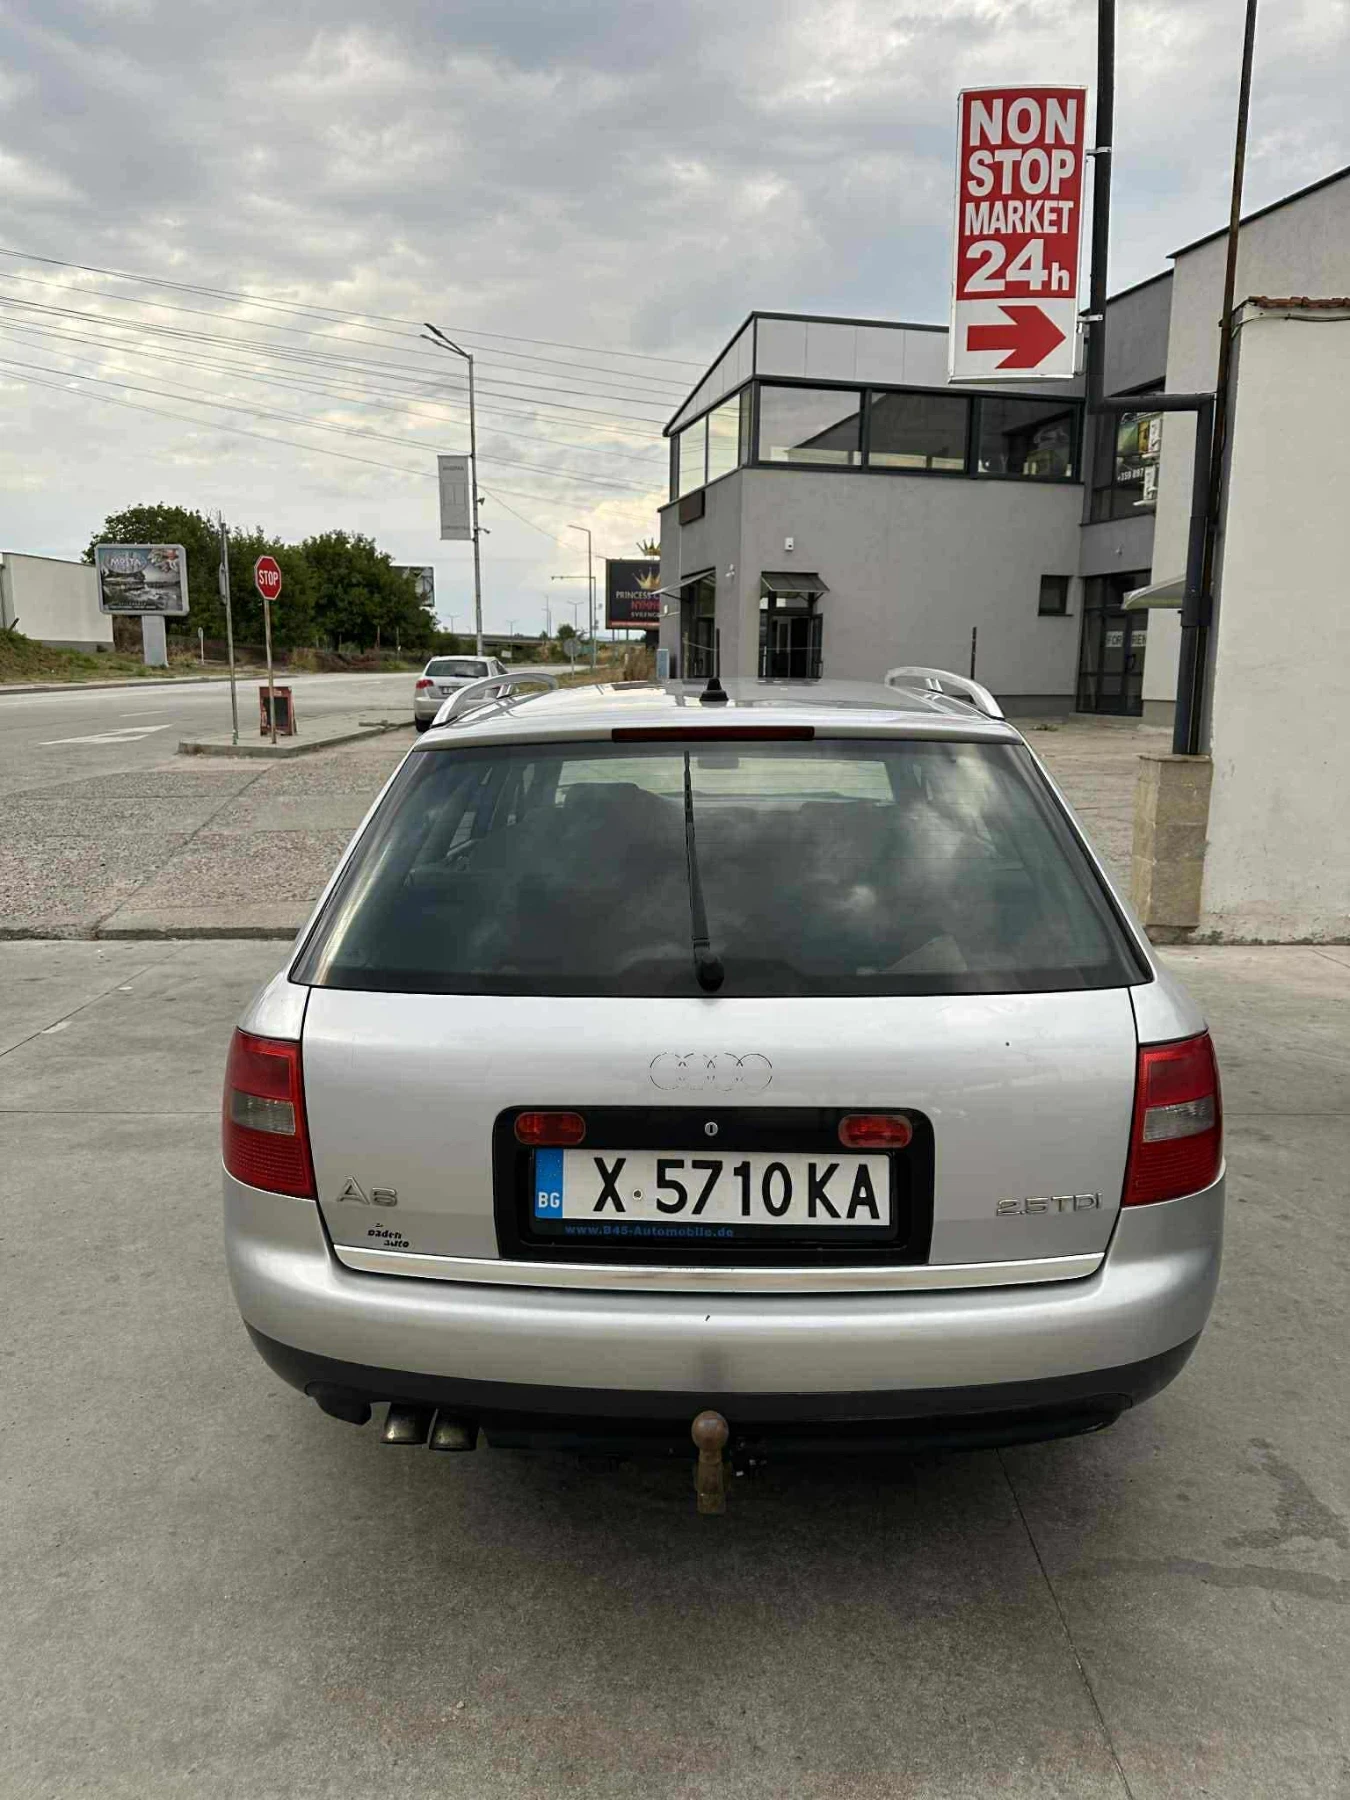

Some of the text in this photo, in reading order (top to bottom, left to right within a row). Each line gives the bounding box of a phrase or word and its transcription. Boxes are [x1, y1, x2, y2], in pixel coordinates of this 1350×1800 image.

[969, 96, 1077, 146] NON
[966, 147, 1075, 197] STOP
[964, 200, 1074, 236] MARKET
[963, 238, 1070, 293] 24h
[258, 570, 279, 586] STOP
[1132, 634, 1146, 645] REN
[537, 1192, 561, 1209] BG
[593, 1157, 880, 1220] X 5710 KA
